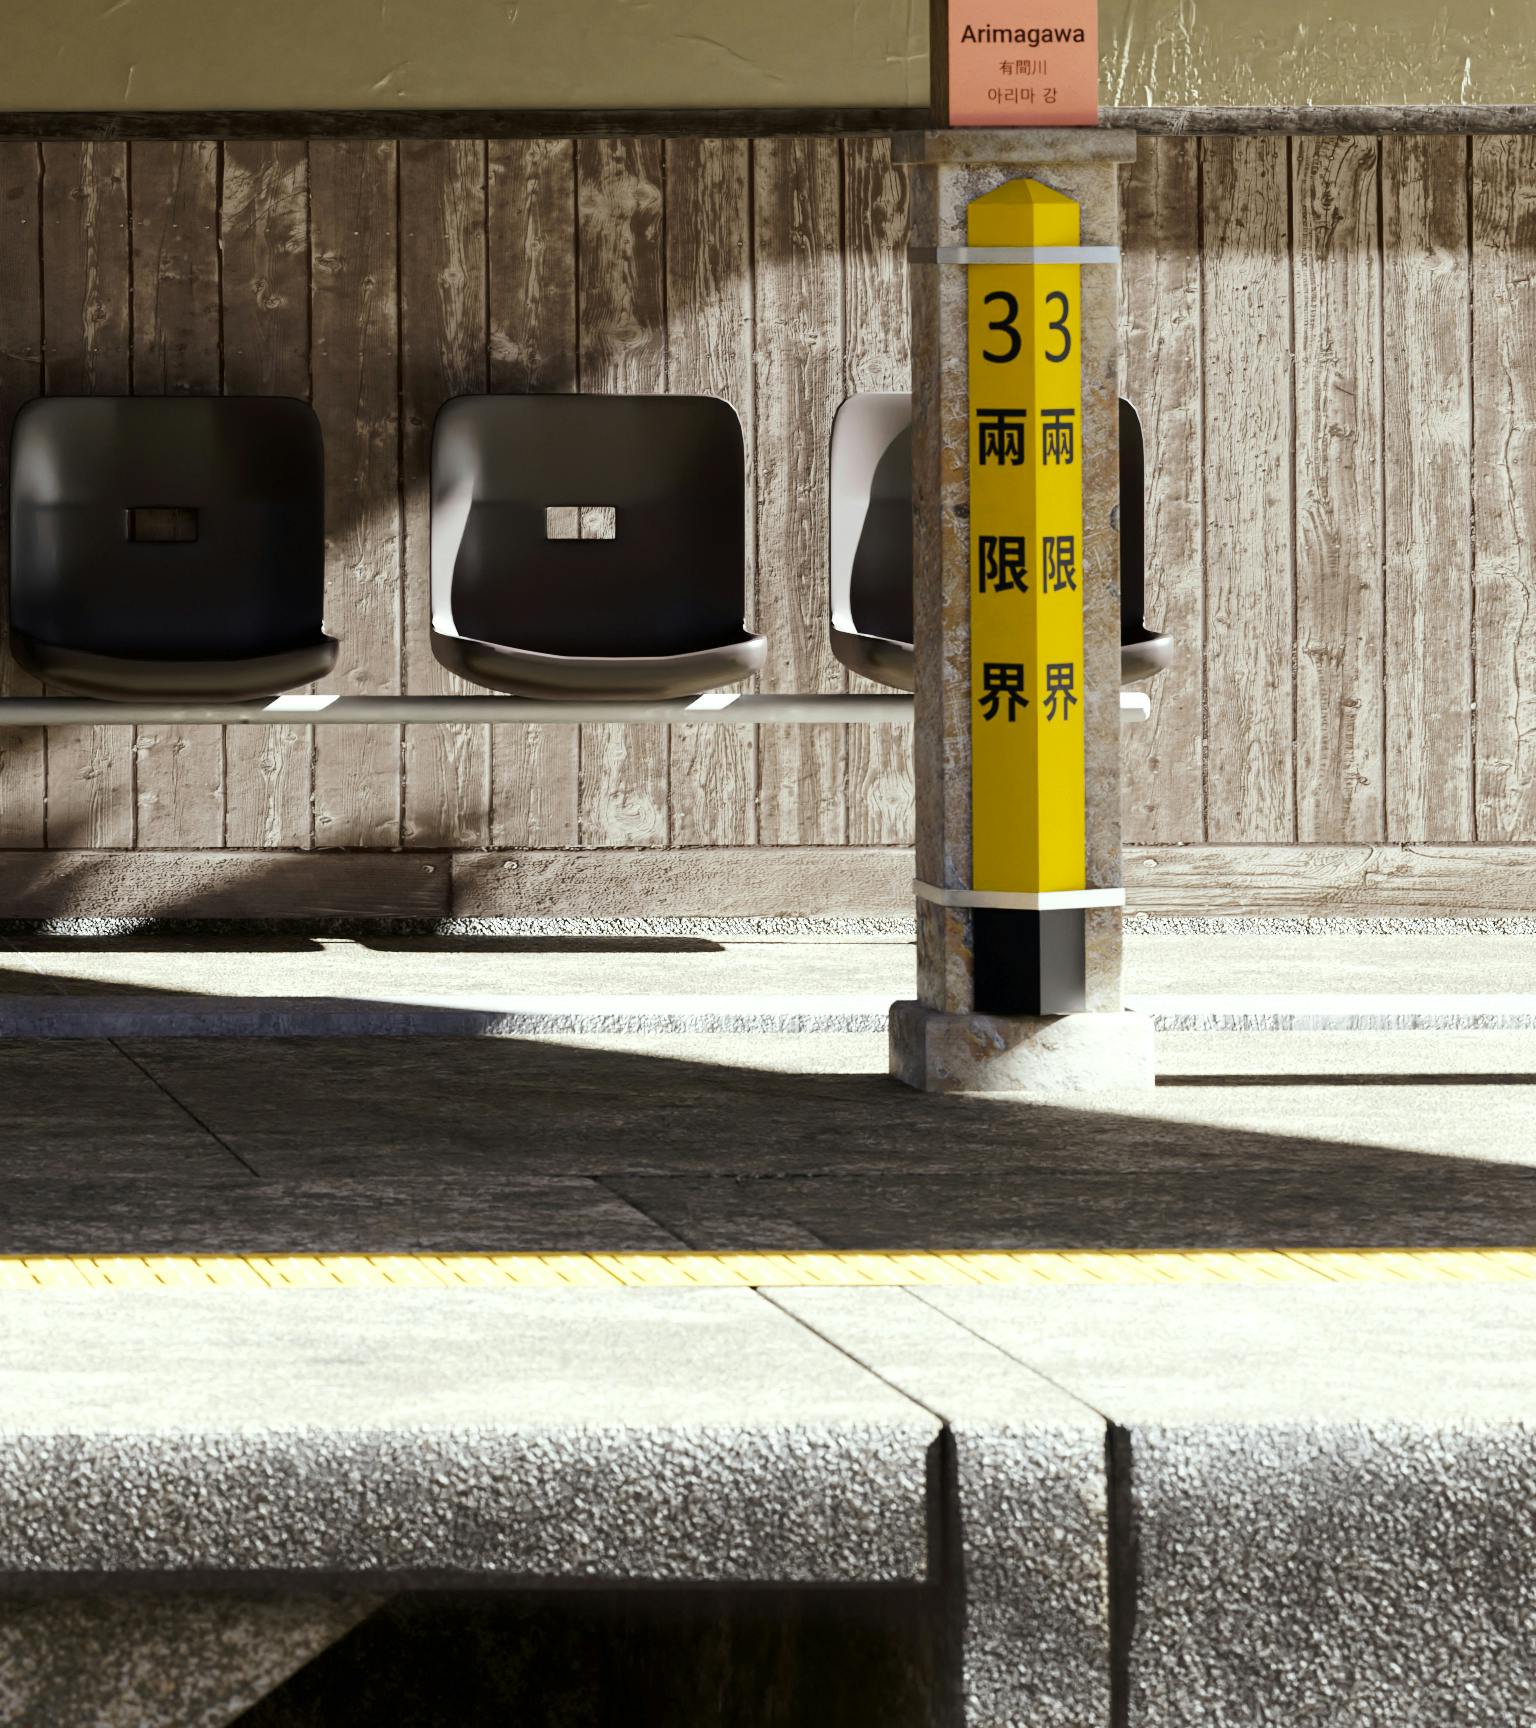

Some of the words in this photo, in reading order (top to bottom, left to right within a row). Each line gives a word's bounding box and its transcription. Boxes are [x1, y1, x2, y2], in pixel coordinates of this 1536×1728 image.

[960, 23, 1086, 49] Arimagawa
[998, 58, 1048, 77] 有間川
[987, 85, 1037, 105] 아리마
[1044, 85, 1058, 105] 강
